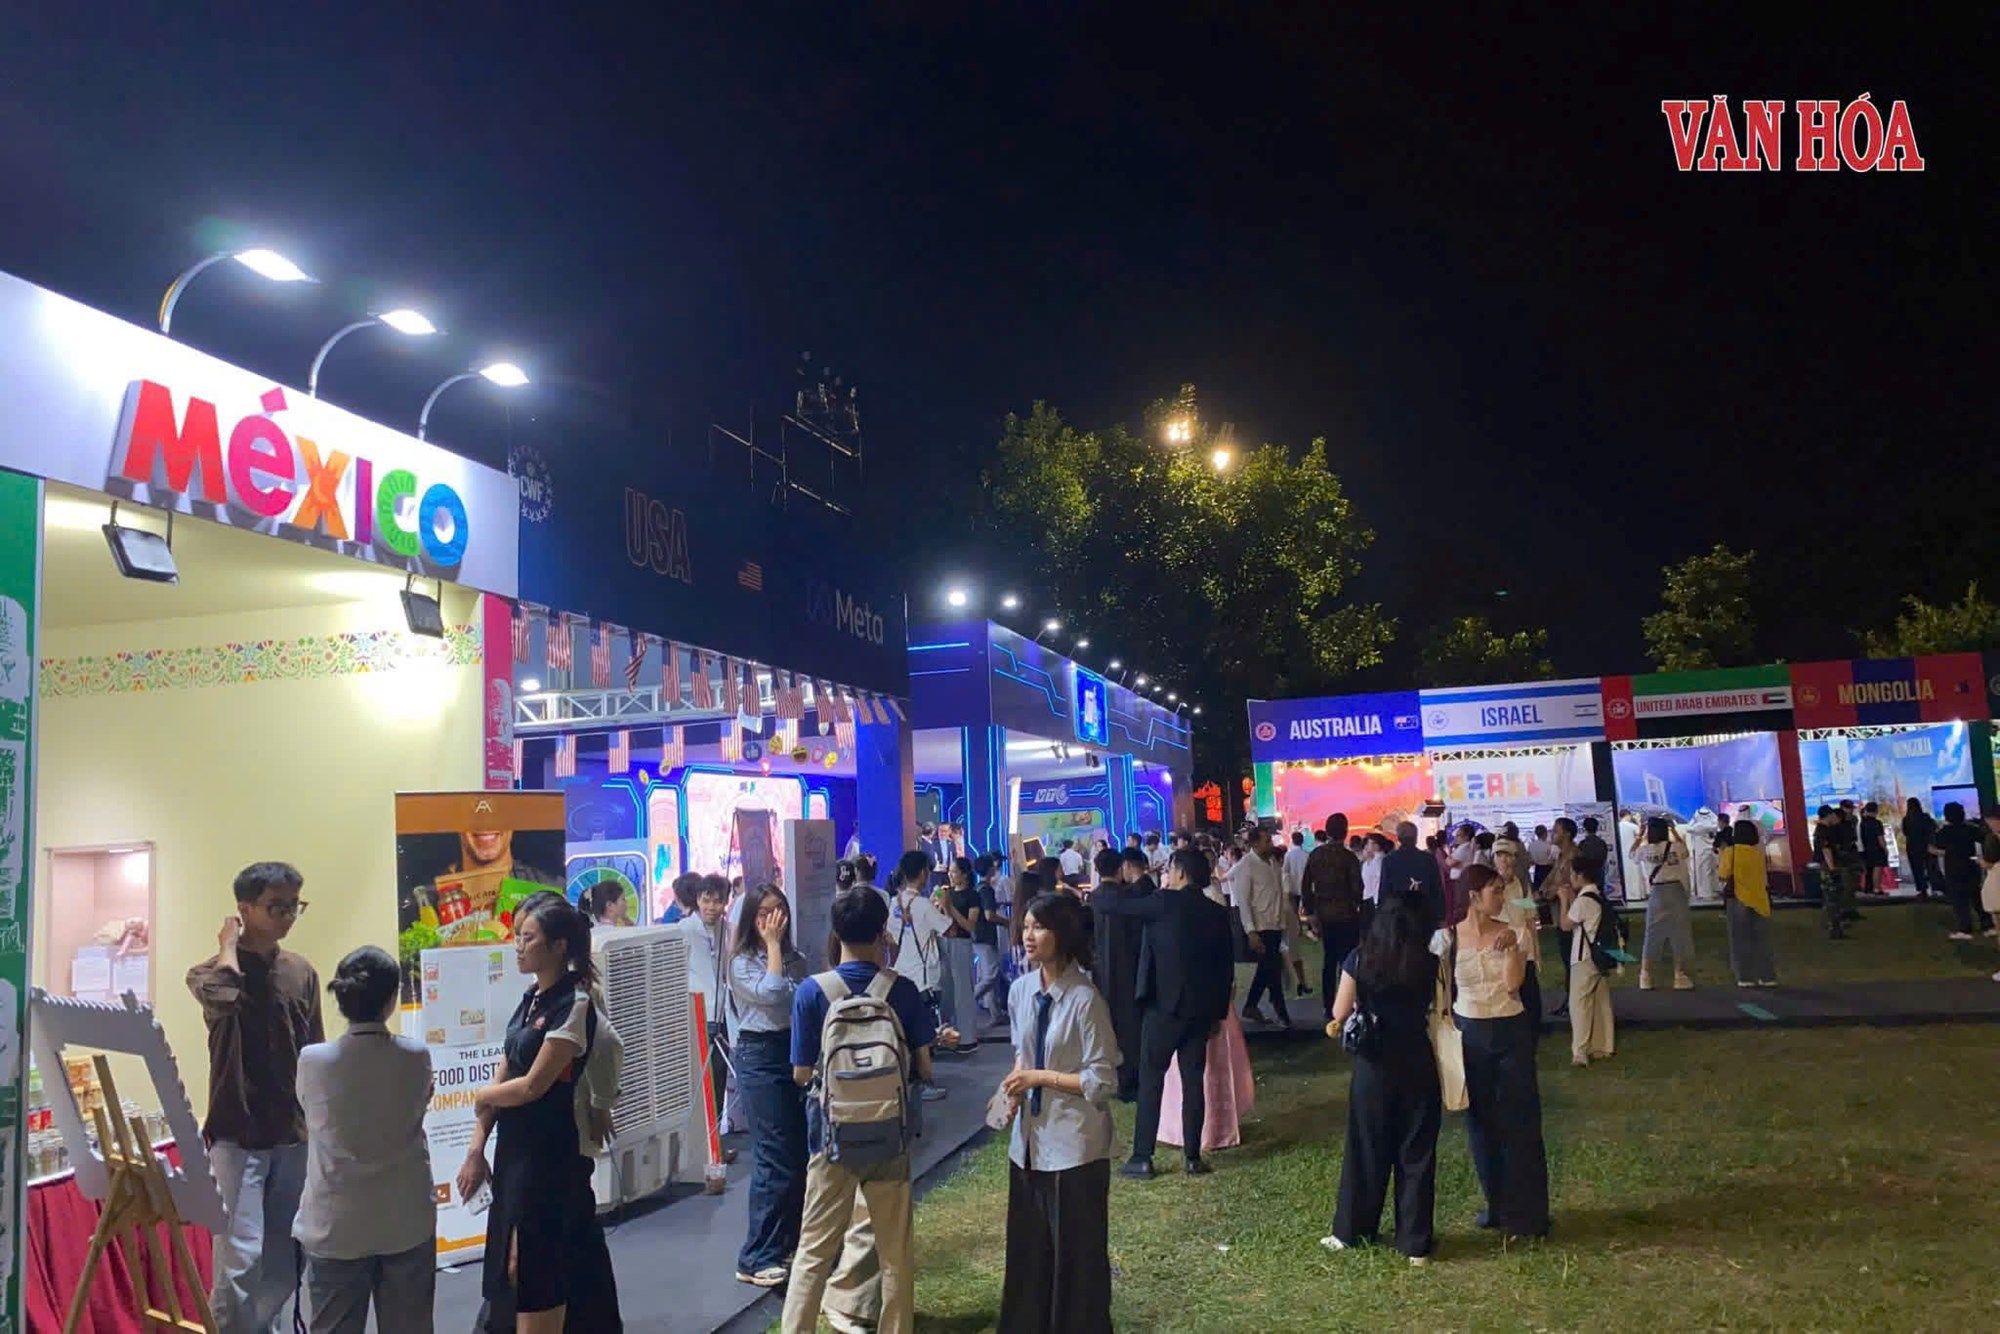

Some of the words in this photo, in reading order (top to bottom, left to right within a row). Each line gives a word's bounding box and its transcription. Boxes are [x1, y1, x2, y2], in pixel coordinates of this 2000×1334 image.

[519, 475, 544, 503] CWF
[624, 485, 693, 585] USA
[835, 587, 884, 647] Meta
[1636, 700, 1673, 714] UNITED
[1675, 697, 1703, 712] ARAB
[1705, 693, 1757, 709] EMIRATES
[1837, 678, 1935, 705] MONGOLIA
[1289, 714, 1383, 741] AUSTRALIA
[1481, 704, 1544, 727] ISRAEL
[459, 1050, 480, 1060] THE
[469, 1062, 501, 1083] DIST
